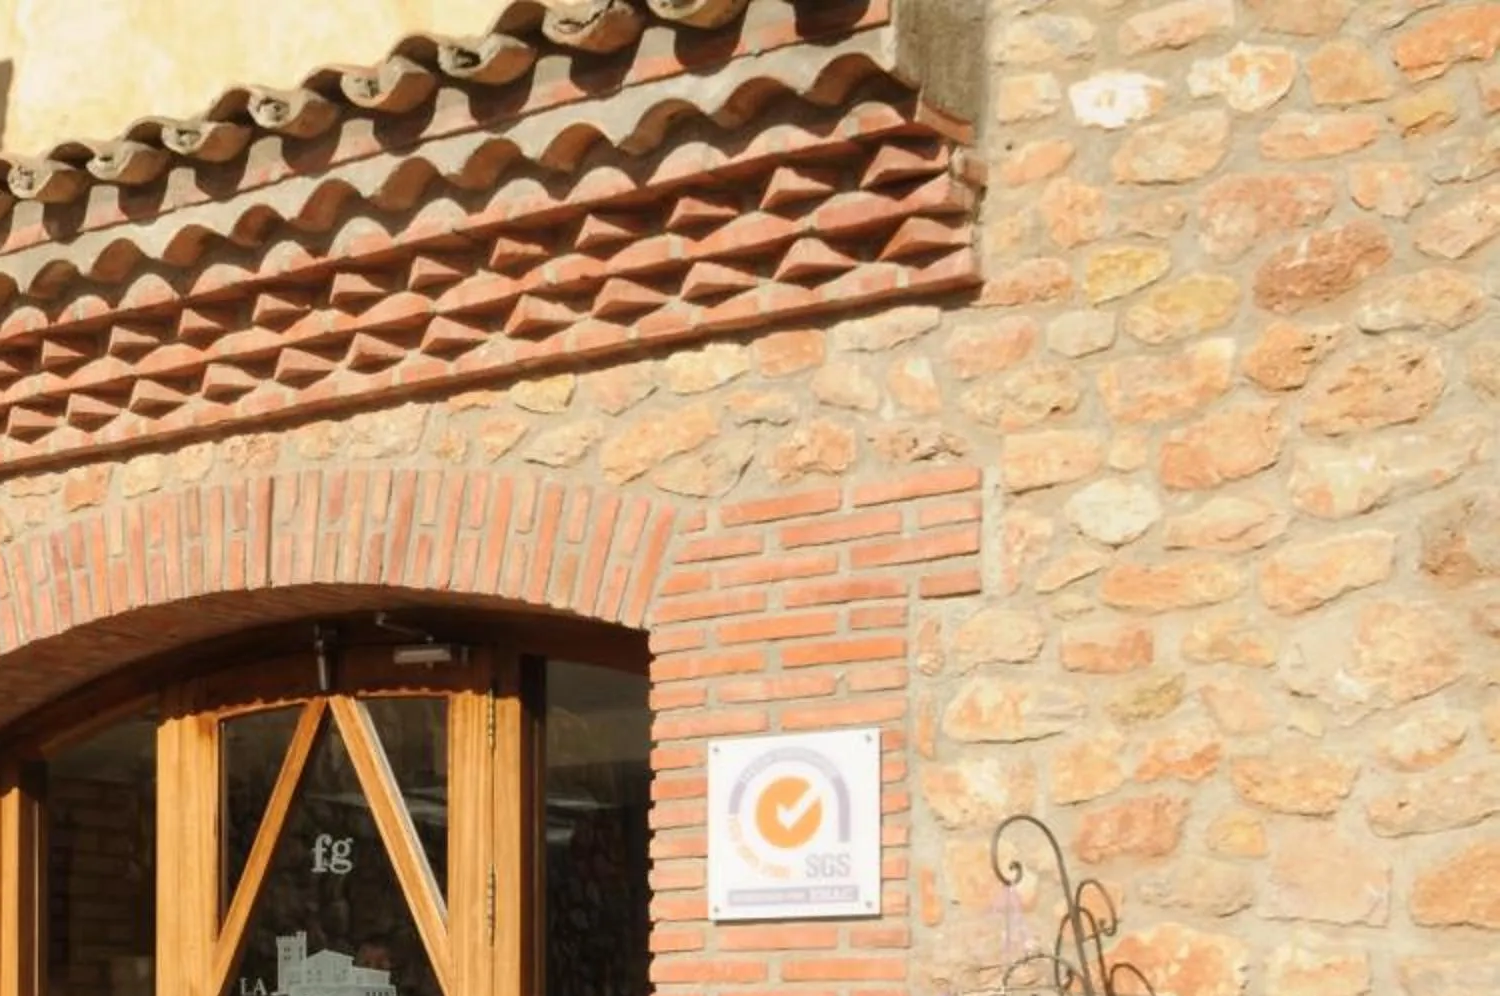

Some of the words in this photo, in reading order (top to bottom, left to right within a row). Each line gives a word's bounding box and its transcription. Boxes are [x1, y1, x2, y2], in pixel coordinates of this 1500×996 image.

[311, 834, 354, 874] fg
[805, 853, 851, 878] SGS
[240, 977, 267, 996] LA
